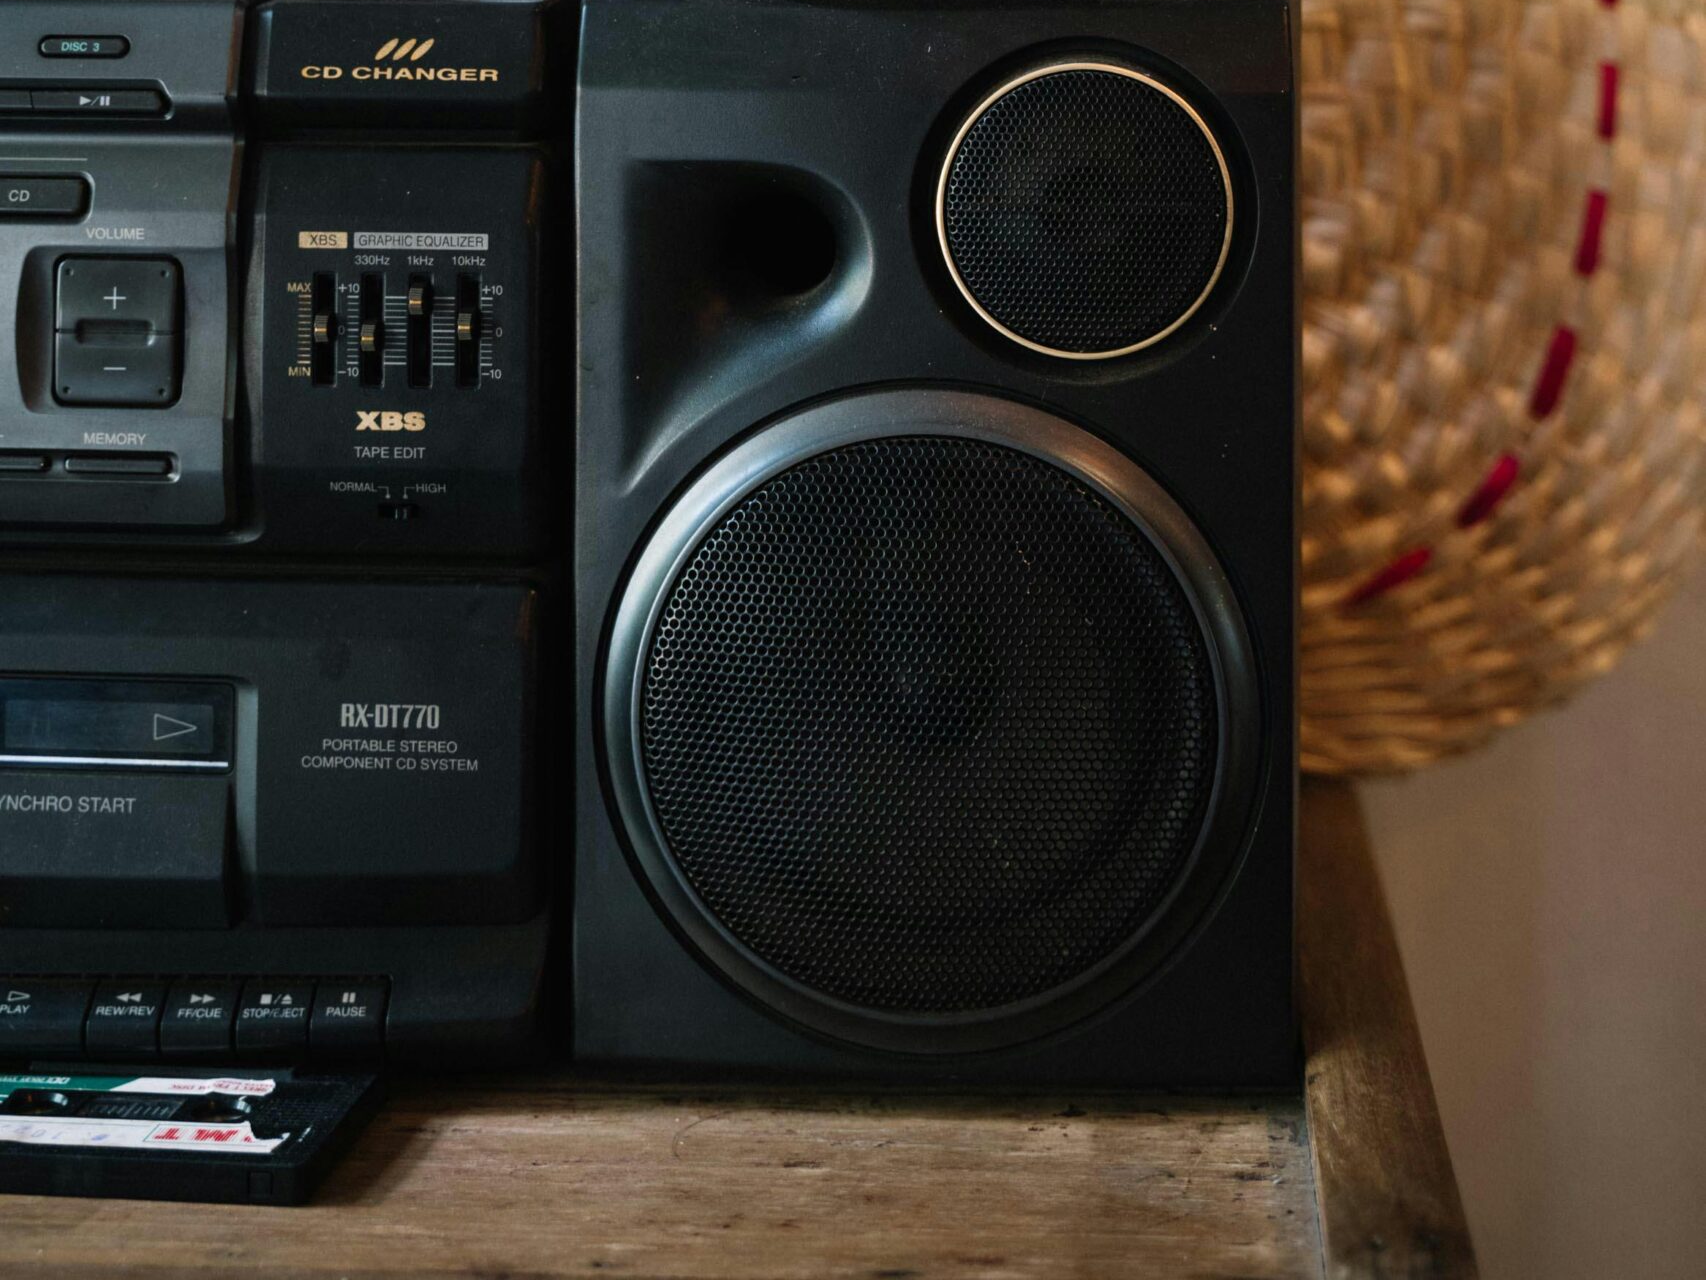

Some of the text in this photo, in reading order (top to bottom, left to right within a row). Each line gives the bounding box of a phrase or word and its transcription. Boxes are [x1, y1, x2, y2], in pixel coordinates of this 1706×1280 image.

[61, 41, 101, 52] DISC 3
[301, 65, 499, 82] CD CHANGER
[8, 189, 30, 202] CD
[85, 227, 145, 240] VOLUME
[309, 234, 337, 246] XBS
[358, 234, 484, 248] GRAPHIC EQUALIZER
[354, 255, 486, 267] 330Hz 1kHz 10kHz
[287, 283, 311, 293] MAX
[338, 283, 360, 293] +10
[482, 285, 503, 296] +10
[495, 327, 503, 338] 0
[287, 368, 311, 377] MIN
[355, 411, 426, 431] XBS
[83, 432, 146, 445] MEMORY
[353, 446, 426, 459] TAPE EDIT
[329, 481, 377, 493] NORMAL
[415, 483, 447, 494] HIGH
[340, 703, 440, 729] RX-DT770
[322, 738, 458, 753] PORTABLE STEREO
[301, 755, 479, 771] COMPONENT CD SYSTEM
[77, 796, 137, 814] START
[0, 1004, 31, 1014] PLAY
[95, 1005, 155, 1016] REW/REV
[176, 1007, 223, 1019] FF/CUE
[242, 1007, 305, 1019] STOP/EJECT
[325, 1006, 367, 1017] PAUSE
